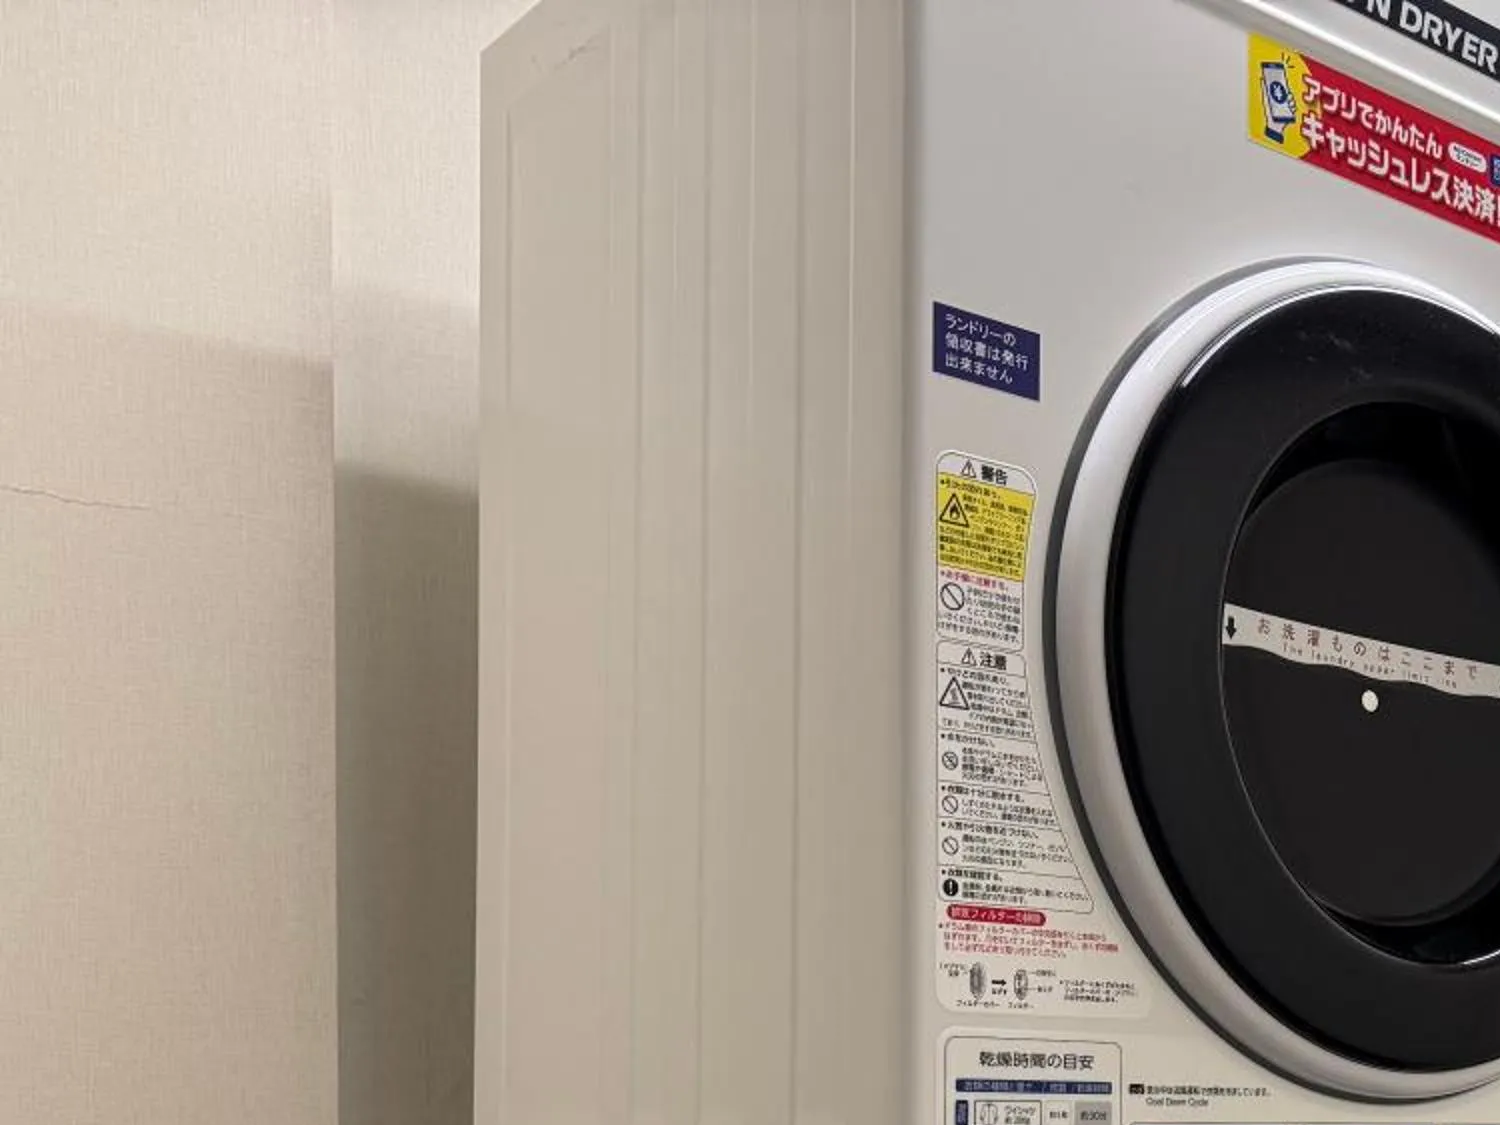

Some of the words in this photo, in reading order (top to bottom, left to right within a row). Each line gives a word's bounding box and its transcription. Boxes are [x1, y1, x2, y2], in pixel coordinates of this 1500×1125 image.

[1399, 1, 1498, 74] DRYER
[1303, 77, 1443, 159] アプリでかんたん
[945, 312, 1017, 347] ランドリーの
[945, 332, 1028, 372] 領収書は発行
[945, 352, 1014, 386] 出来ません
[981, 464, 1008, 486] 警告
[980, 652, 1007, 671] 注意
[1258, 617, 1478, 681] お洗濯ものはここまで
[979, 1051, 1096, 1071] 乾燥時間の目安
